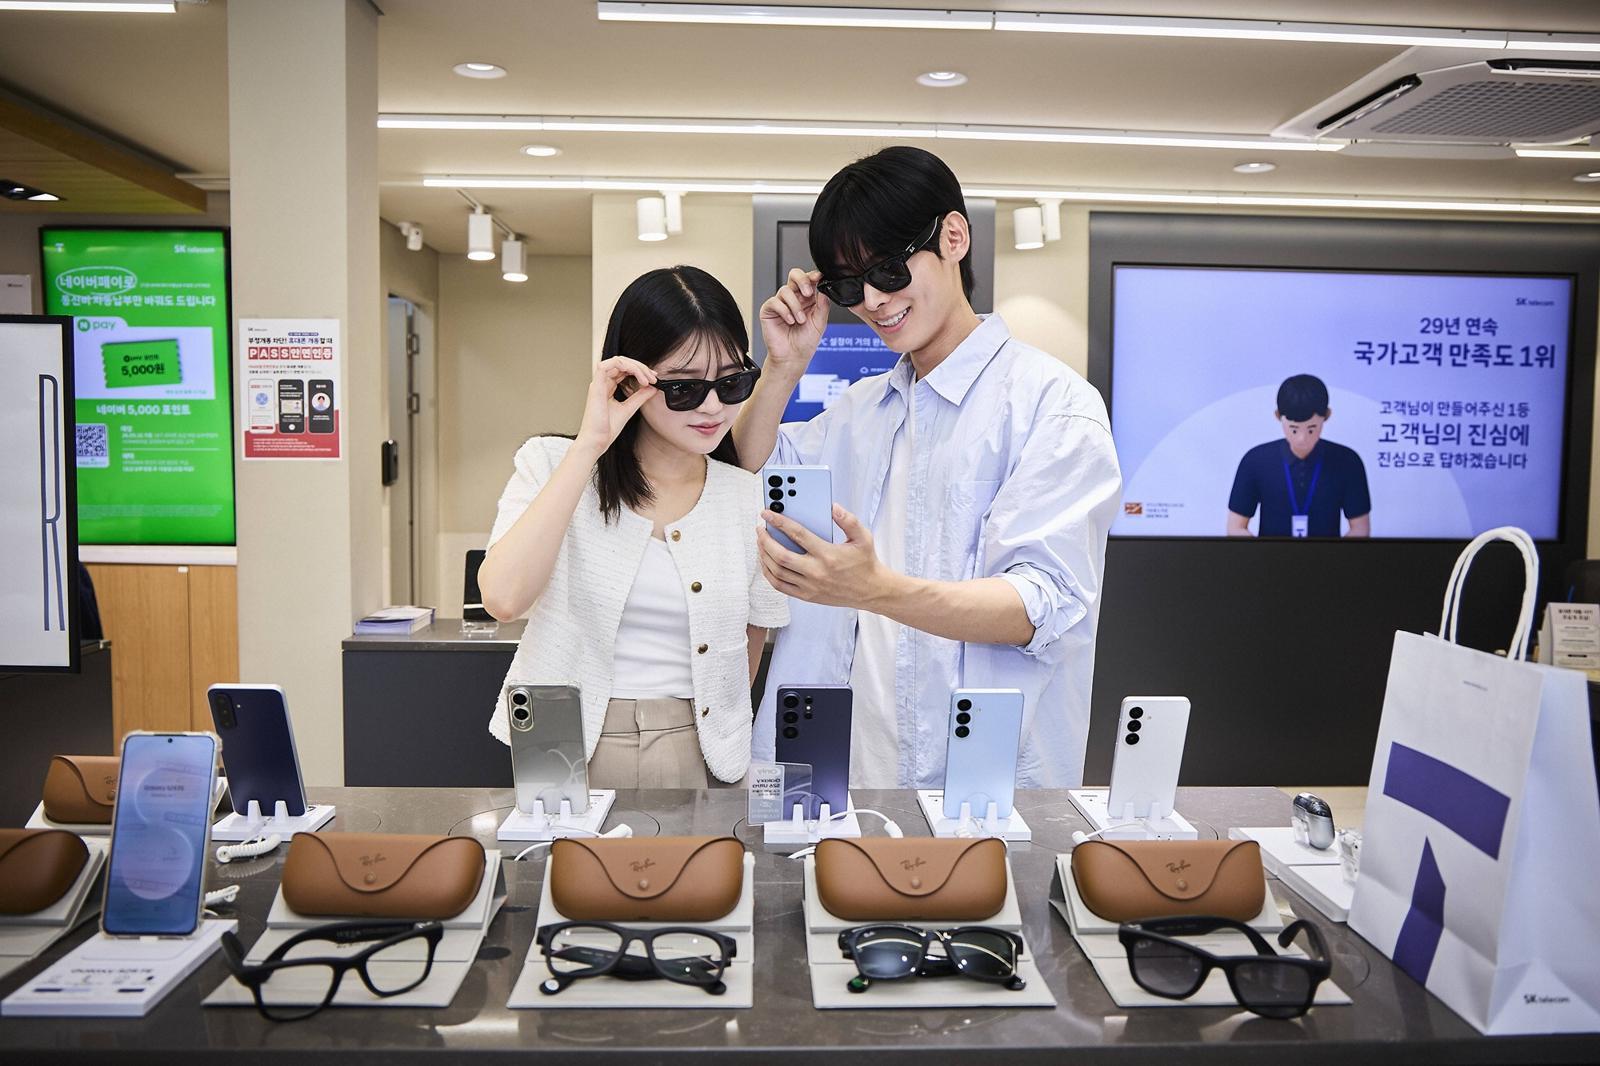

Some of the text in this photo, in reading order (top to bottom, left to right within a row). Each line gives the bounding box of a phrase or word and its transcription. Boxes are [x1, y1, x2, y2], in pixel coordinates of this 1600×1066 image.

[60, 275, 135, 289] 네이버페이로
[176, 295, 216, 307] 드립니다
[1516, 298, 1527, 306] SK
[1420, 317, 1498, 336] 29년 연속
[1354, 341, 1555, 369] 국가고객 만족도 1위
[121, 363, 165, 377] 5,000원
[96, 404, 191, 416] 네이버 5,000 포인트
[1380, 401, 1530, 418] 고객님이 만들어주신 1등
[1378, 423, 1530, 447] 고객님의 진심에
[1377, 452, 1528, 469] 진심으로 답하겠습니다
[1523, 994, 1536, 1004] SK
